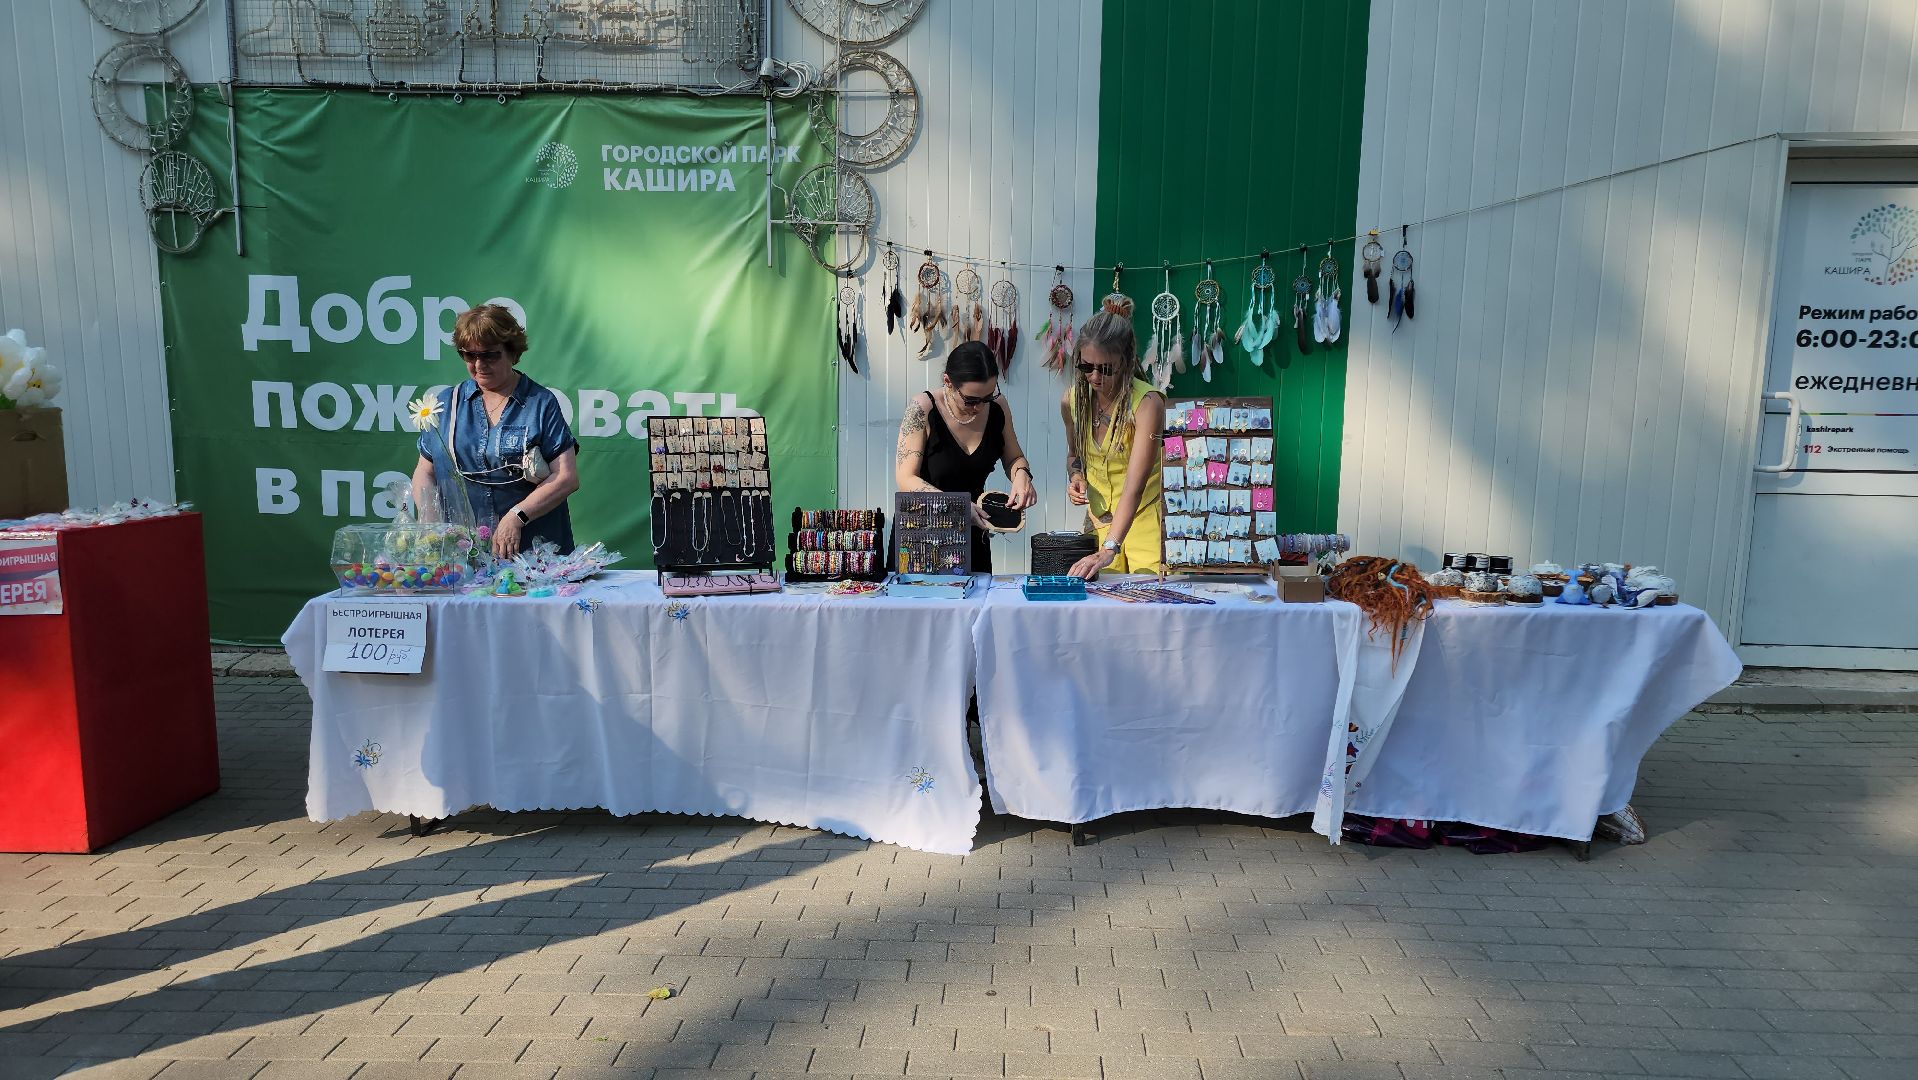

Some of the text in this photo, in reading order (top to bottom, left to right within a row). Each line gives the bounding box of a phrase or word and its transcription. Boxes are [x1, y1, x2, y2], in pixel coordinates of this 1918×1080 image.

[601, 141, 801, 165] ГОРОДСКОЙ ПАРК
[603, 167, 737, 192] КАШИРА
[1824, 266, 1871, 275] КАШИРА
[1799, 305, 1865, 320] Режим
[1806, 425, 1854, 434] kashirapark
[1803, 445, 1822, 454] 112
[255, 467, 301, 515] в
[0, 581, 47, 604] ЕРЕЯ
[348, 627, 405, 640] ЛОТЕРЕЯ
[346, 642, 388, 661] 100
